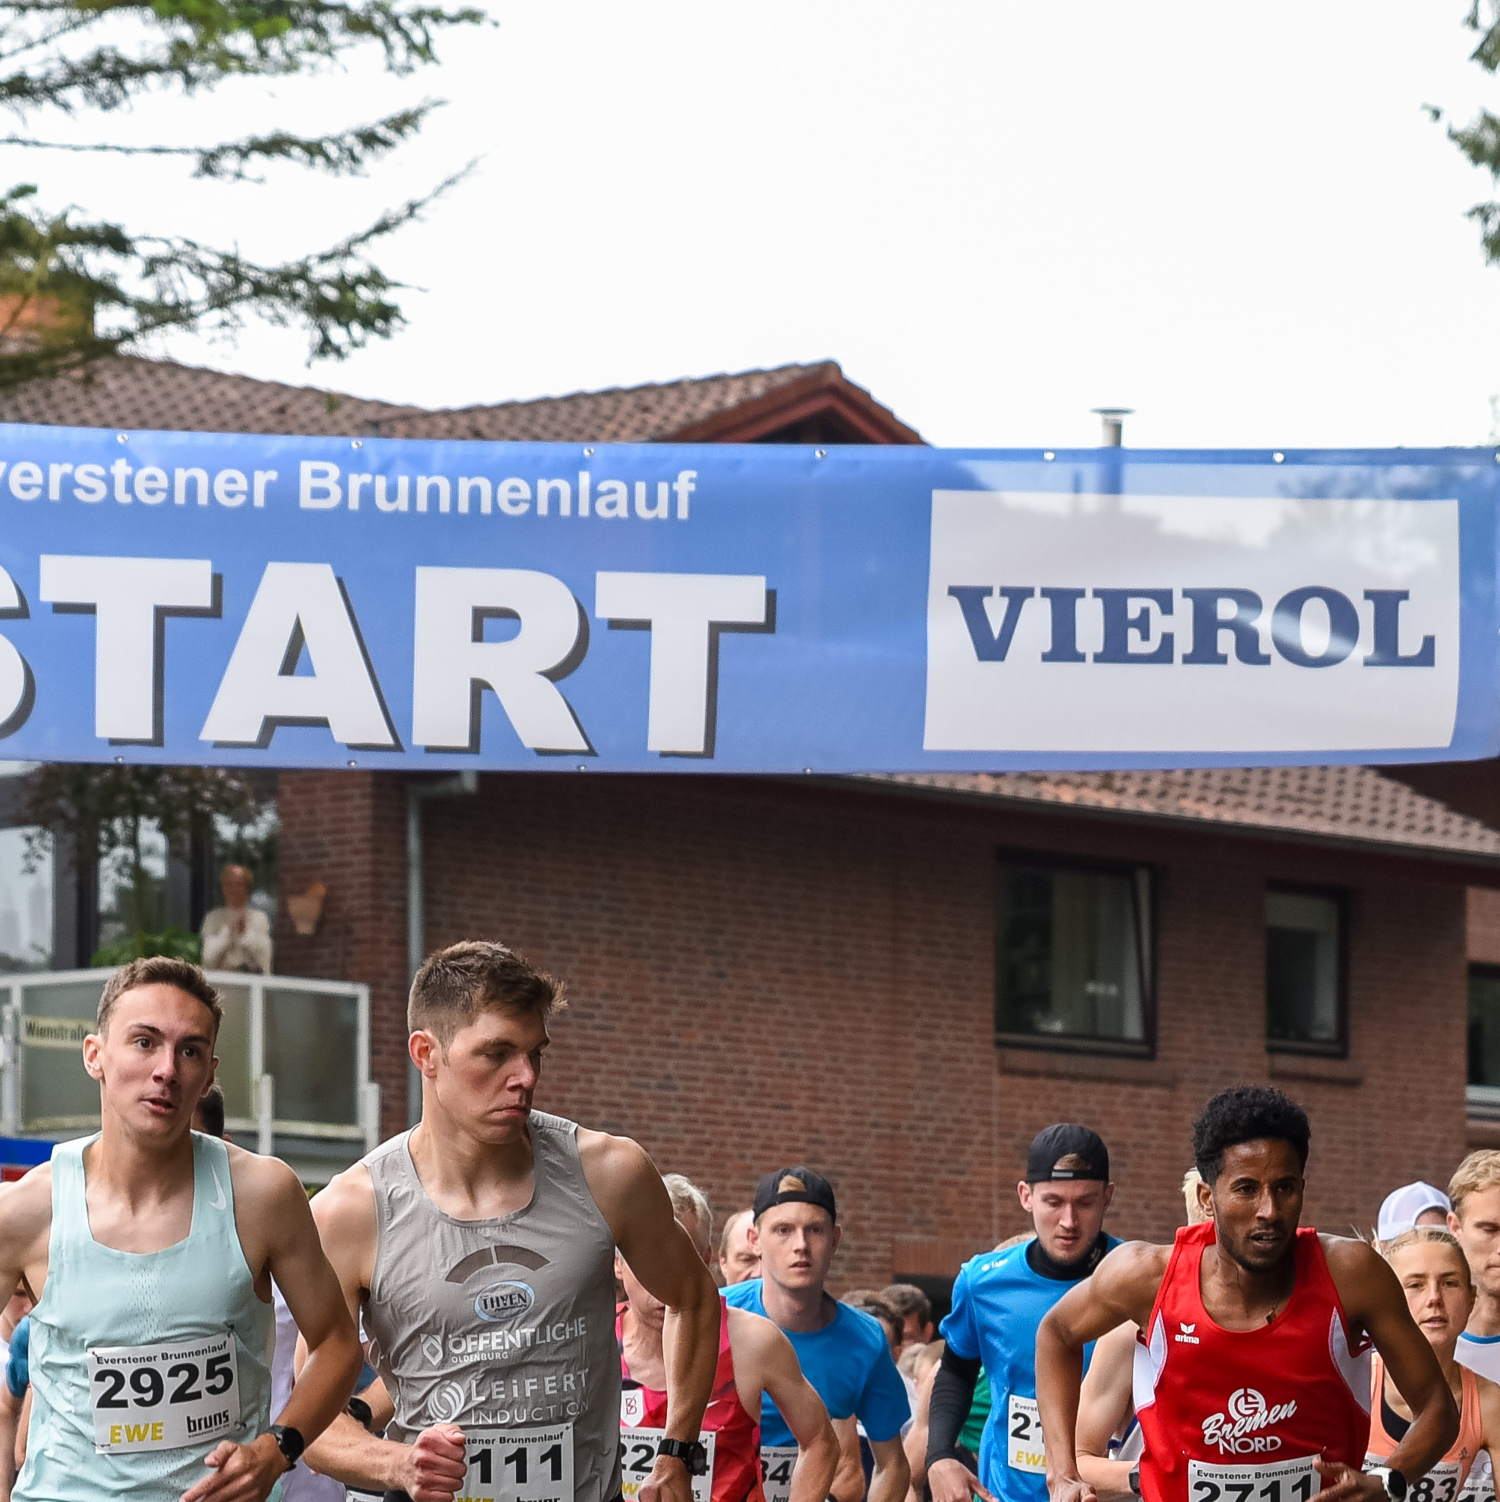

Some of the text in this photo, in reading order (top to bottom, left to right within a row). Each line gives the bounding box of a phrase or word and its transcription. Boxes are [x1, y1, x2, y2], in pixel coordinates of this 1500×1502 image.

[299, 459, 697, 521] Brunnenlauf
[947, 585, 1436, 668] VIEROL
[96, 1340, 228, 1366] Everstener Brunnenlauf
[448, 1316, 588, 1354] ÖFFENTLICHE
[451, 1351, 509, 1364] OLDENBURG
[94, 1352, 234, 1409] 2925
[109, 1421, 164, 1445] EWE
[186, 1408, 229, 1434] bruns
[471, 1400, 589, 1425] INDUCTION
[1202, 1399, 1298, 1446] Bremen
[499, 1431, 564, 1445] Brunnenlauf
[1218, 1435, 1282, 1455] NORD
[468, 1443, 562, 1485] 111
[1196, 1469, 1252, 1480] Everstener
